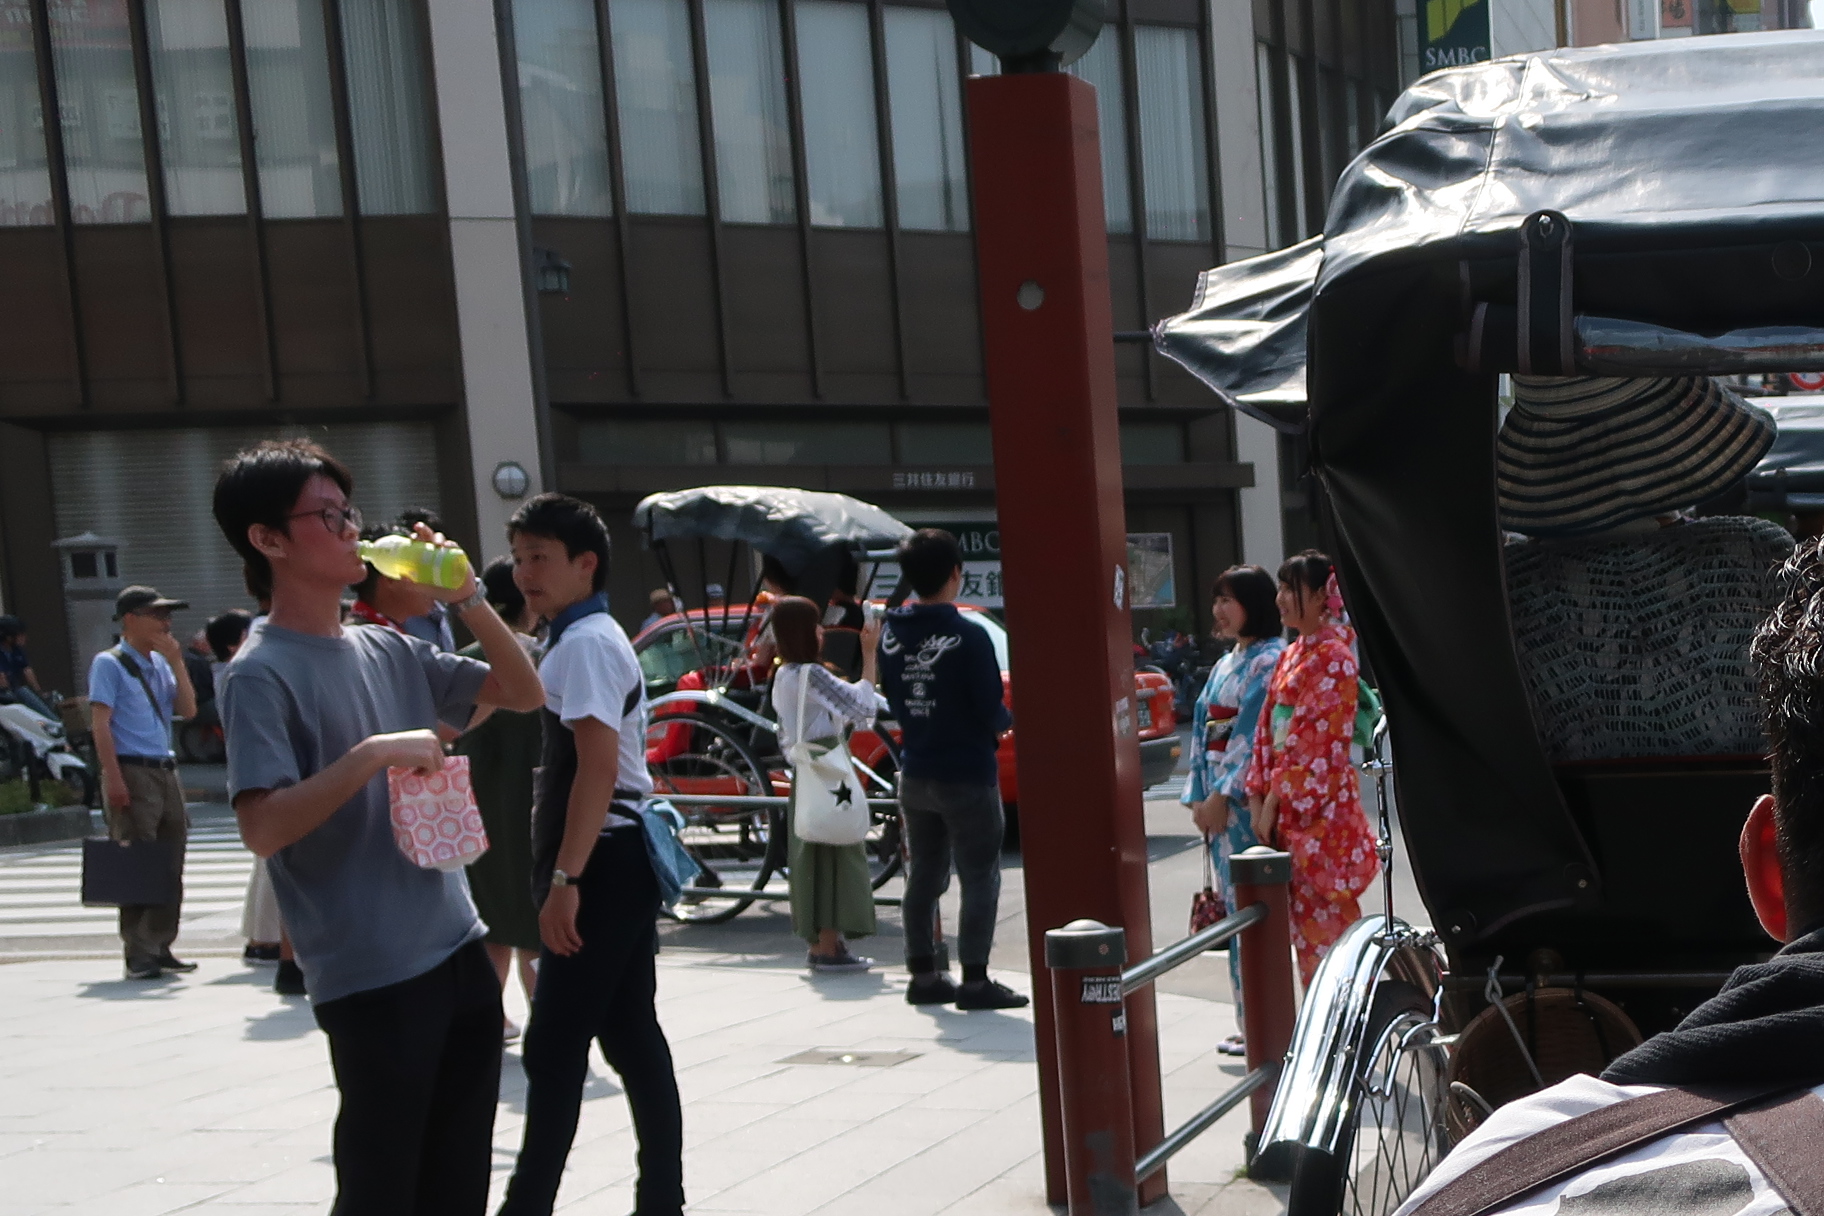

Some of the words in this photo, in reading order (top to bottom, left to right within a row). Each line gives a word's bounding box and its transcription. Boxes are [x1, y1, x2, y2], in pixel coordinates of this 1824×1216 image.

[1425, 47, 1486, 66] SMBC
[892, 472, 974, 488] 三井住友銀行
